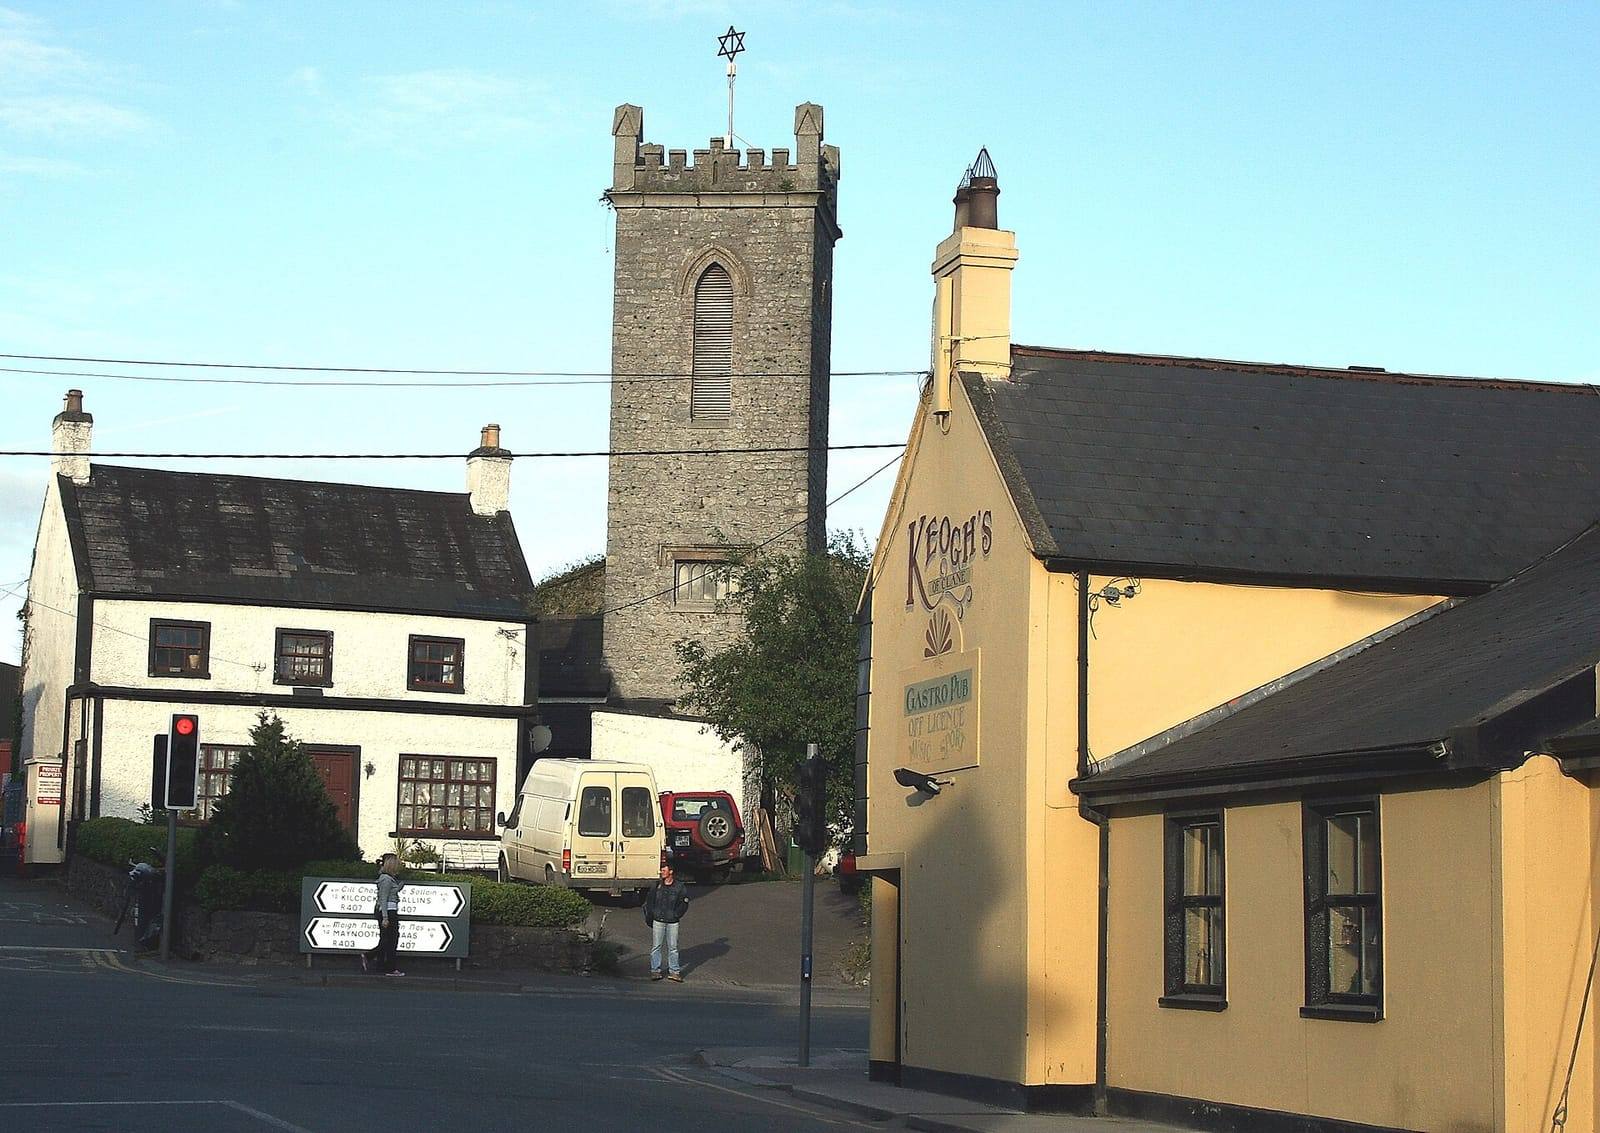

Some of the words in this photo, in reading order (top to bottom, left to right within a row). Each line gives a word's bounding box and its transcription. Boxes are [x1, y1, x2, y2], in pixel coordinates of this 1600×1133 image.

[906, 509, 992, 609] KEOGH'S
[906, 683, 949, 712] GASTRO
[950, 675, 969, 702] PUB
[908, 715, 924, 738] OFF
[927, 706, 966, 734] LICENCE
[332, 939, 356, 948] R403
